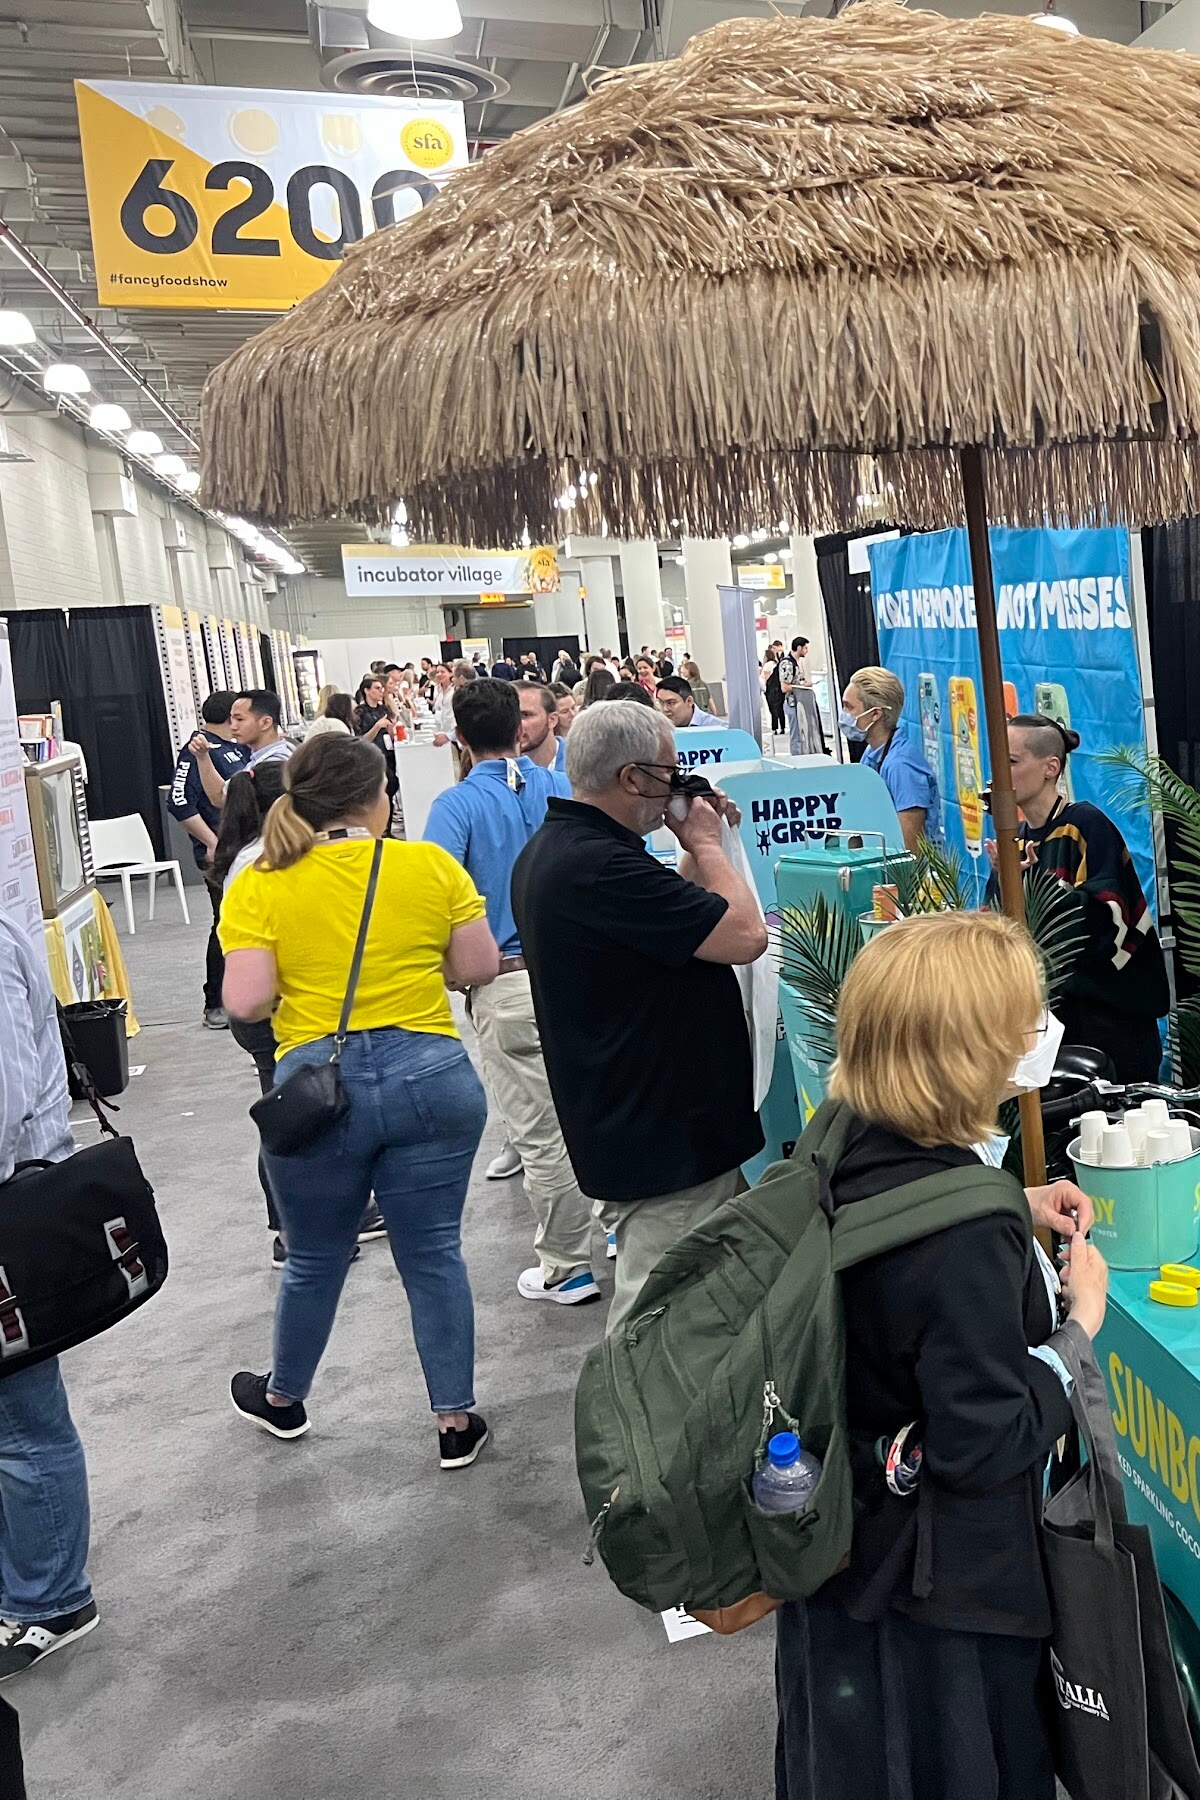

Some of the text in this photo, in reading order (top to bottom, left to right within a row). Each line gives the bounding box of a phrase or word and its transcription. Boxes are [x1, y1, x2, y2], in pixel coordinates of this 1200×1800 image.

[413, 133, 443, 149] sfa
[110, 273, 228, 289] #fancyfoodshow
[358, 565, 503, 586] incubator village
[912, 584, 977, 629] MEMORIE
[678, 748, 723, 766] APPY
[751, 793, 839, 823] HAPPY
[1132, 1471, 1175, 1530] SPARKLING
